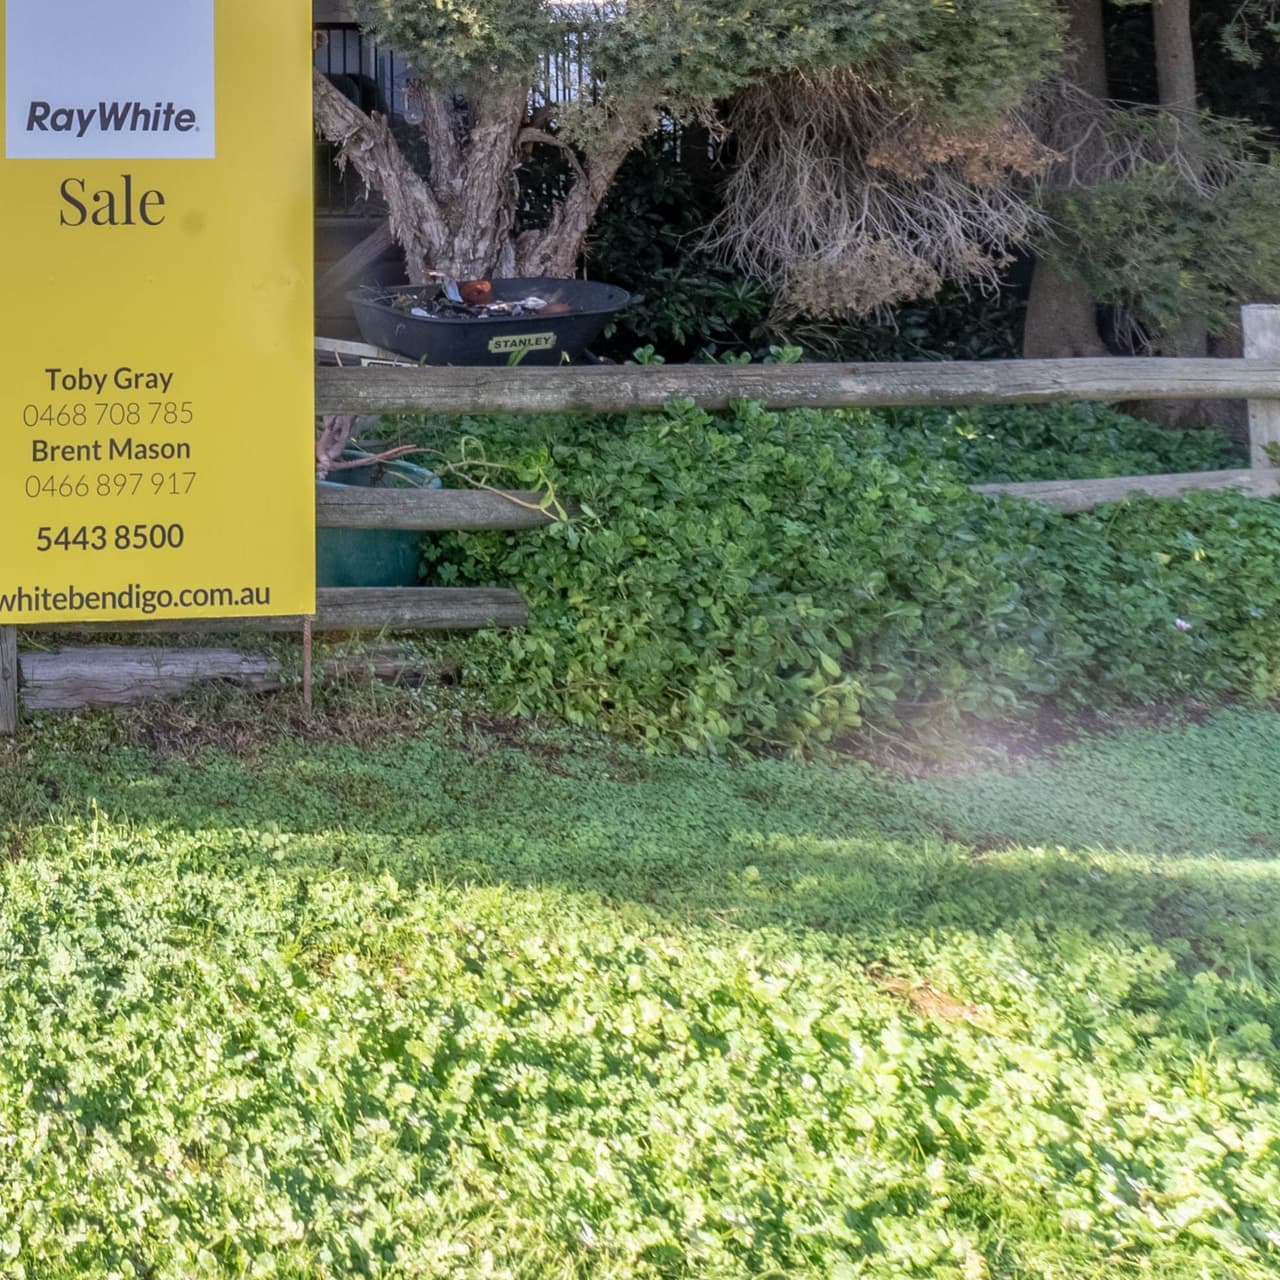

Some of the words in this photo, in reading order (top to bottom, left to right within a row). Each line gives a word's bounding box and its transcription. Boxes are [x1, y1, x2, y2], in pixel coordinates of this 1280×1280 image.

[59, 174, 166, 227] Sale
[494, 336, 551, 349] STANLEY
[45, 367, 108, 395] Toby
[113, 367, 174, 394] Gray
[23, 403, 87, 427] 0468
[95, 402, 141, 426] 708
[148, 401, 194, 425] 785
[32, 438, 102, 462] Brent
[109, 437, 191, 460] Mason
[25, 474, 89, 498] 0466
[96, 473, 143, 496] 897
[151, 471, 197, 495] 917
[36, 524, 107, 552] 5443
[114, 523, 185, 550] 8500
